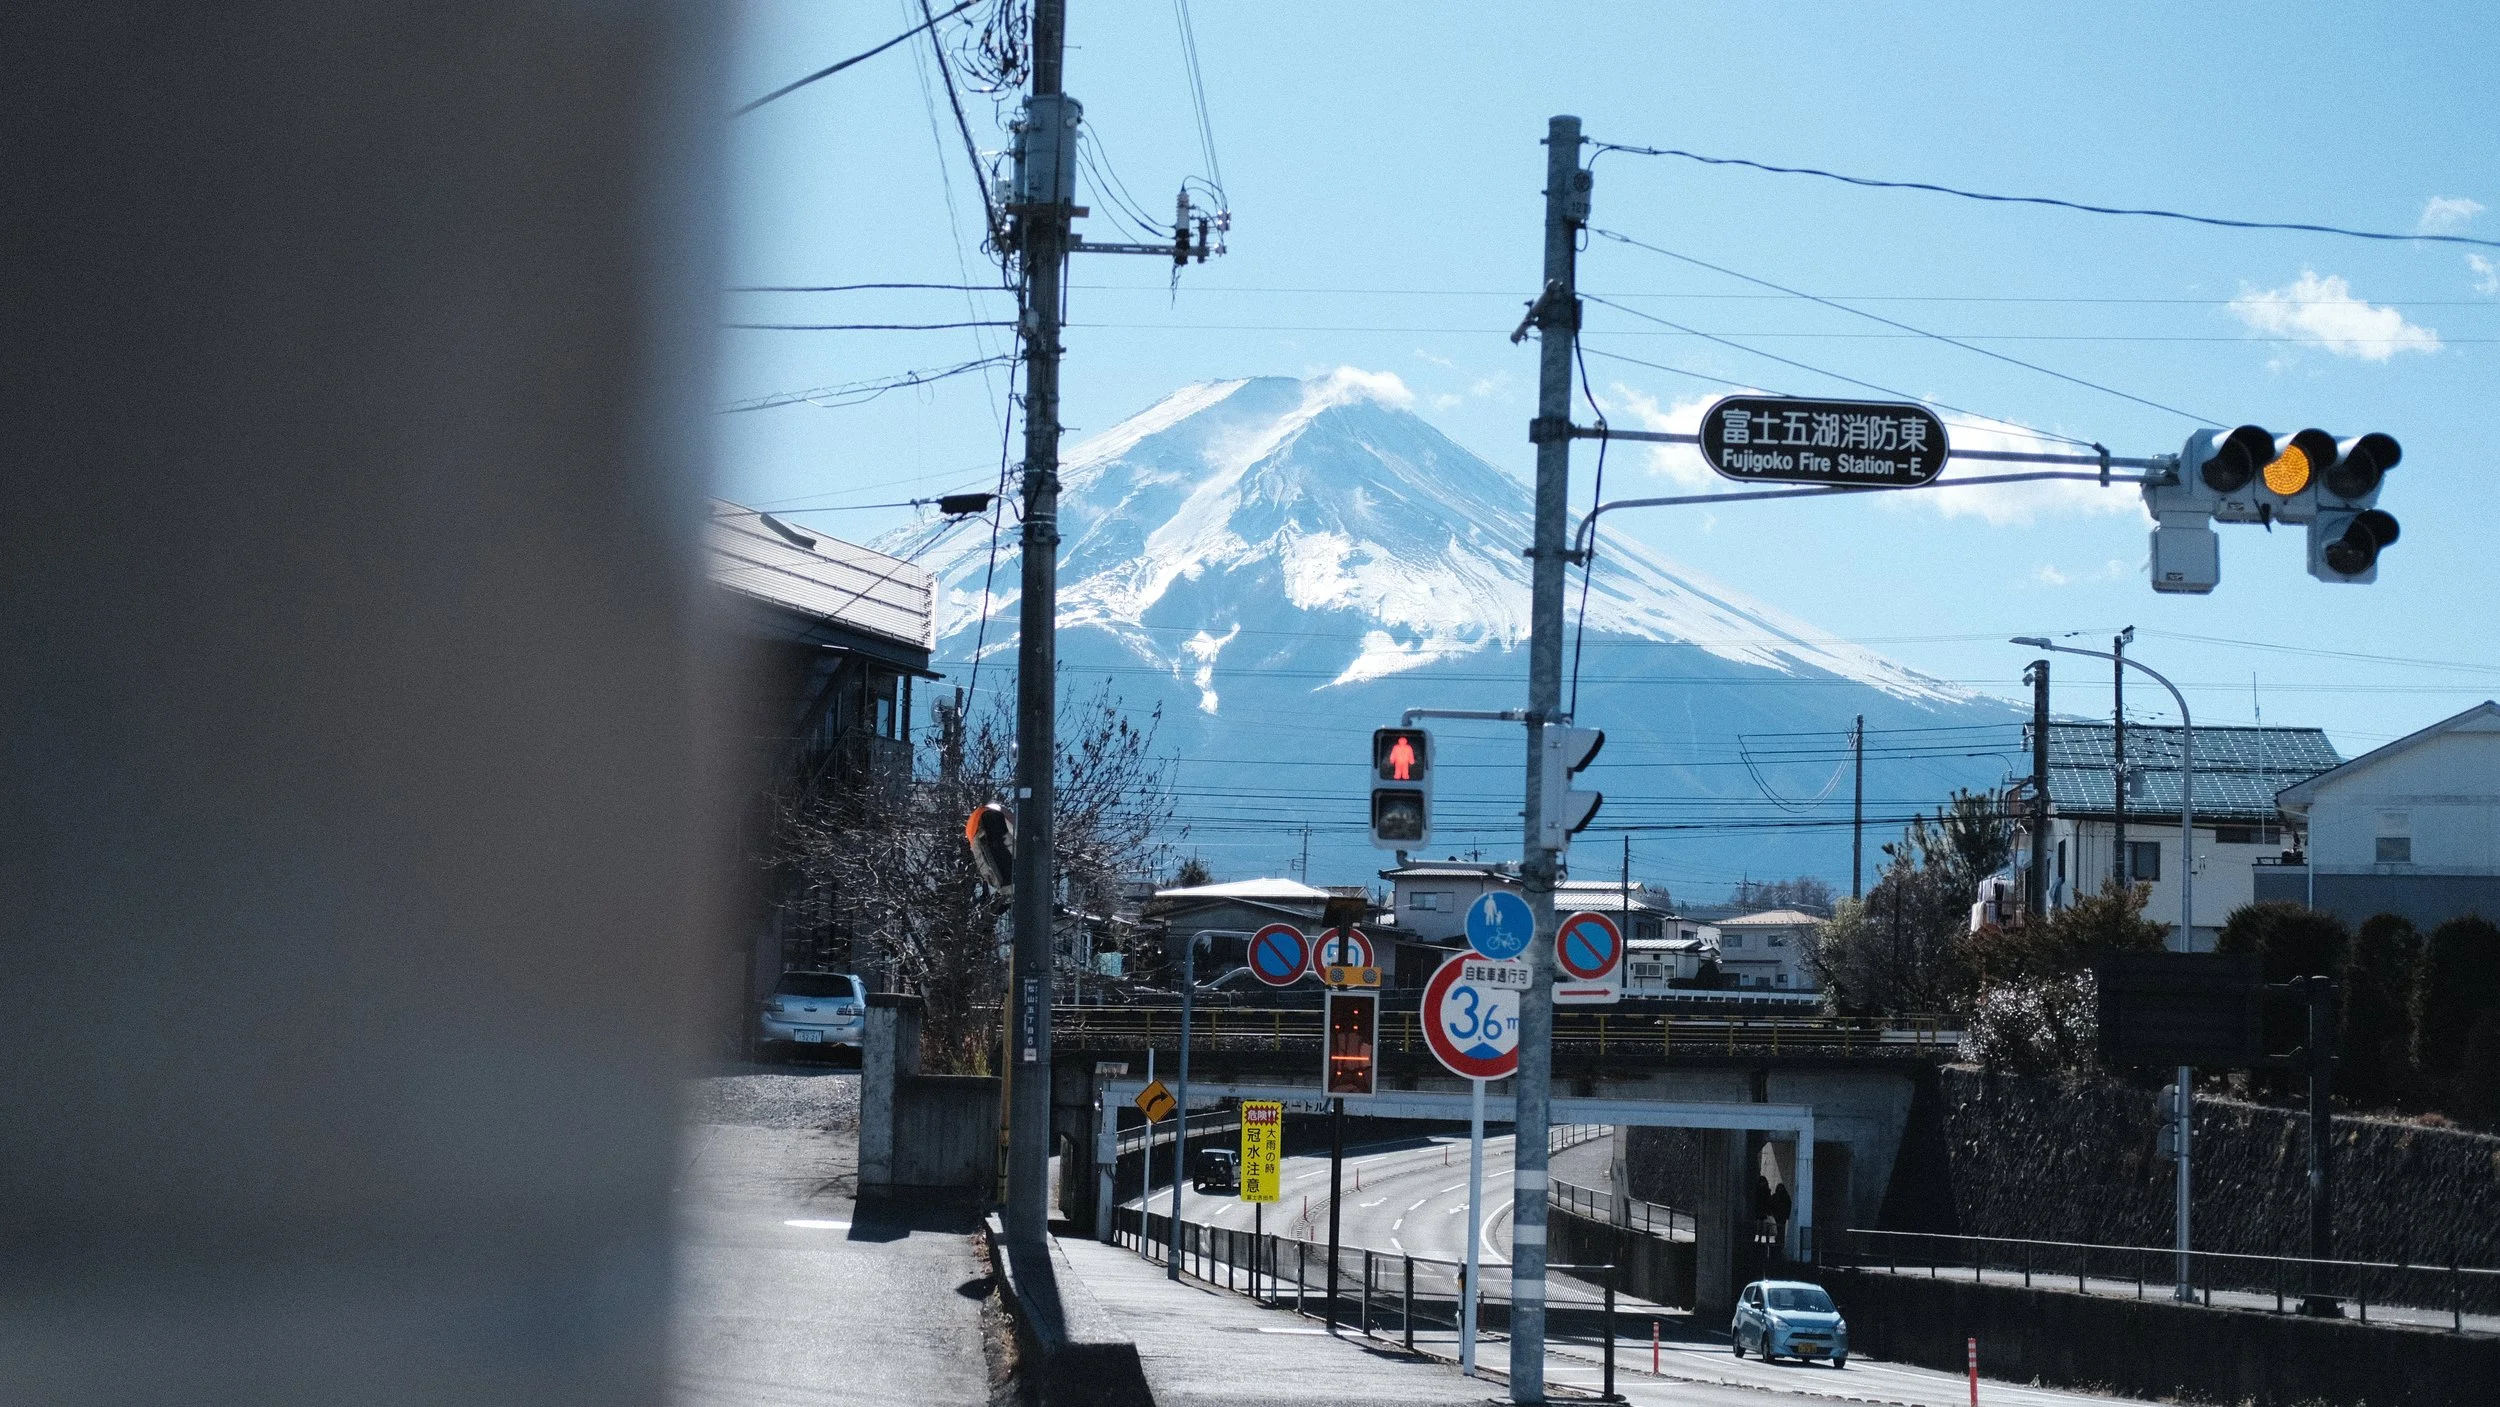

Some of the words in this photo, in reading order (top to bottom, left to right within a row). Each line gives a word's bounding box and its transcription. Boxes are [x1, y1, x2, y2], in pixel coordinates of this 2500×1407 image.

[1722, 408, 1929, 452] 富士五湖消防東
[1722, 449, 1793, 472] Fujigoko
[1800, 452, 1831, 472] Fire
[1465, 966, 1529, 984] 自転車通行可
[1247, 1109, 1276, 1121] 危険!!
[1246, 1128, 1260, 1192] 冠水注意
[1265, 1128, 1276, 1174] 大雨の時
